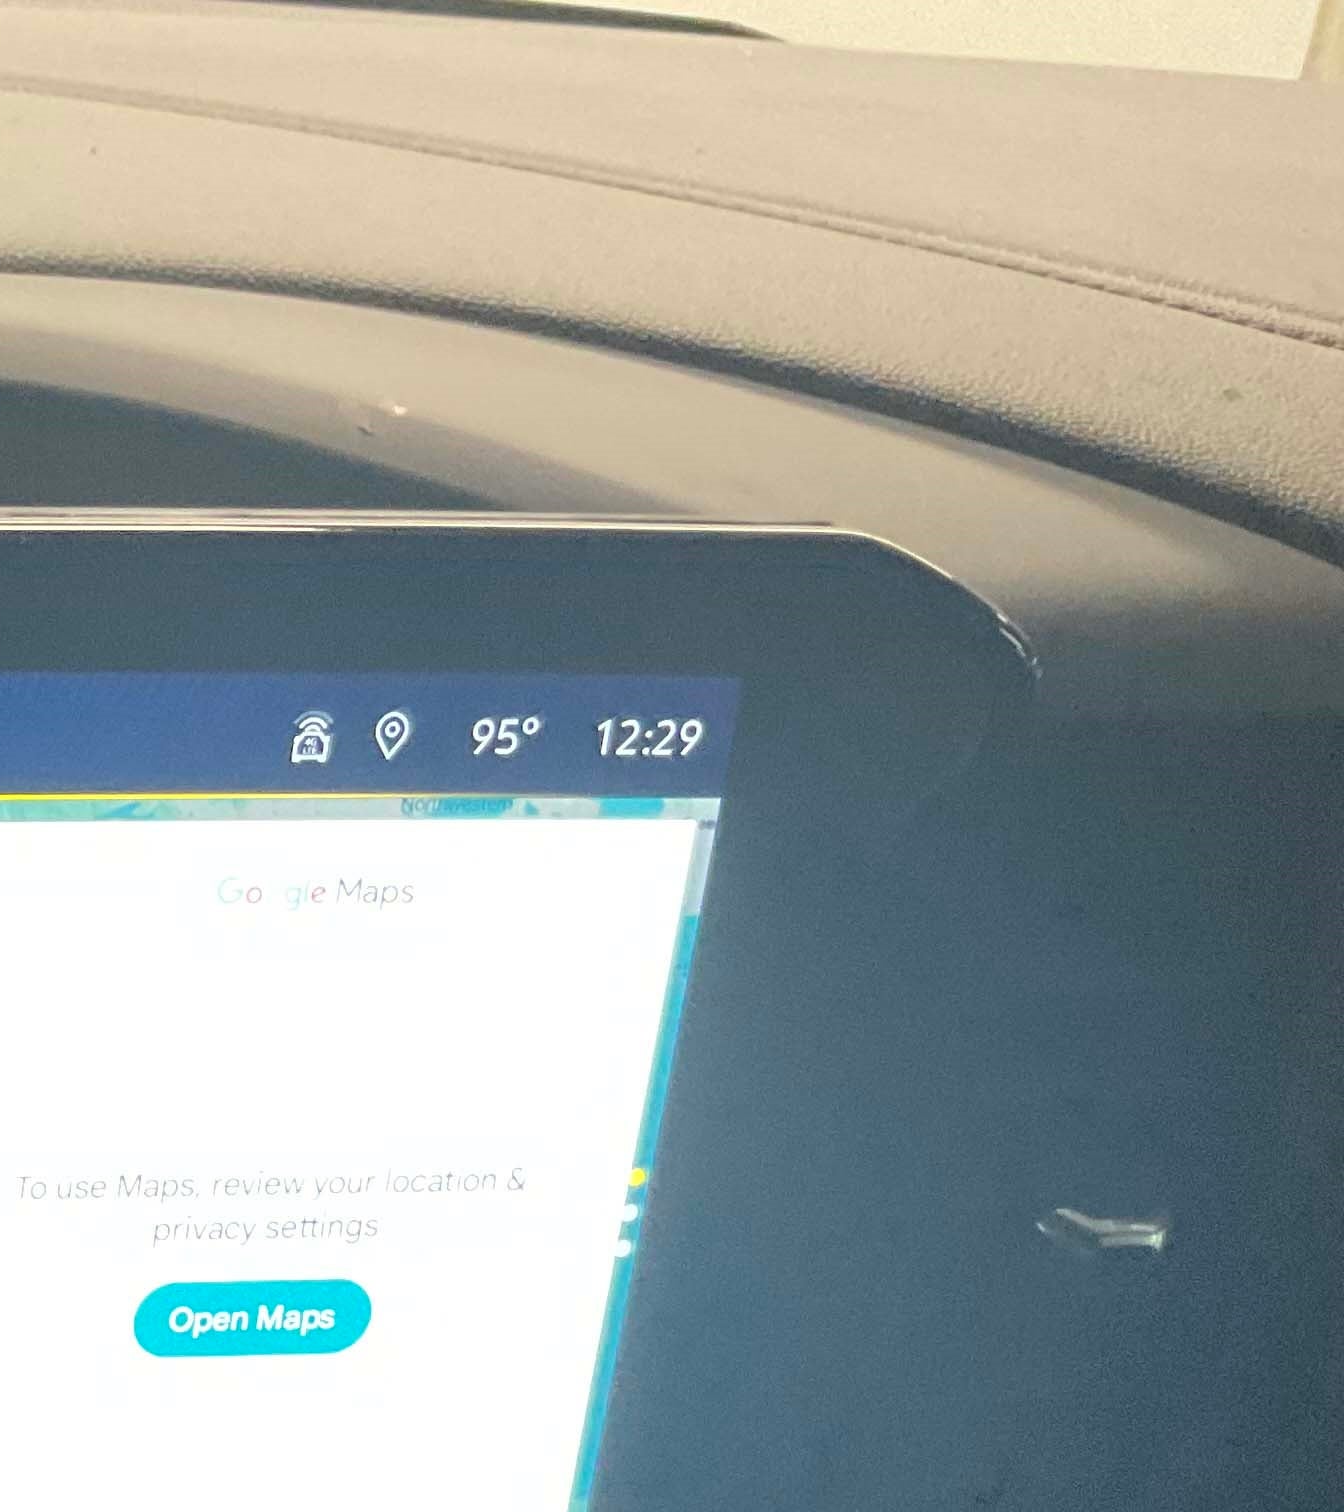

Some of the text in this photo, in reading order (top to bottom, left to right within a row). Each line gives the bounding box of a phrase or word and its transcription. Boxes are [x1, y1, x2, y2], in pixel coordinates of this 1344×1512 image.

[472, 717, 541, 755] 95°
[597, 718, 703, 756] 12:29
[217, 877, 414, 911] Gogle Maps
[16, 1167, 526, 1203] To use Maps, review your location &
[153, 1209, 379, 1247] privacy settings
[168, 1304, 335, 1338] Open Maps
